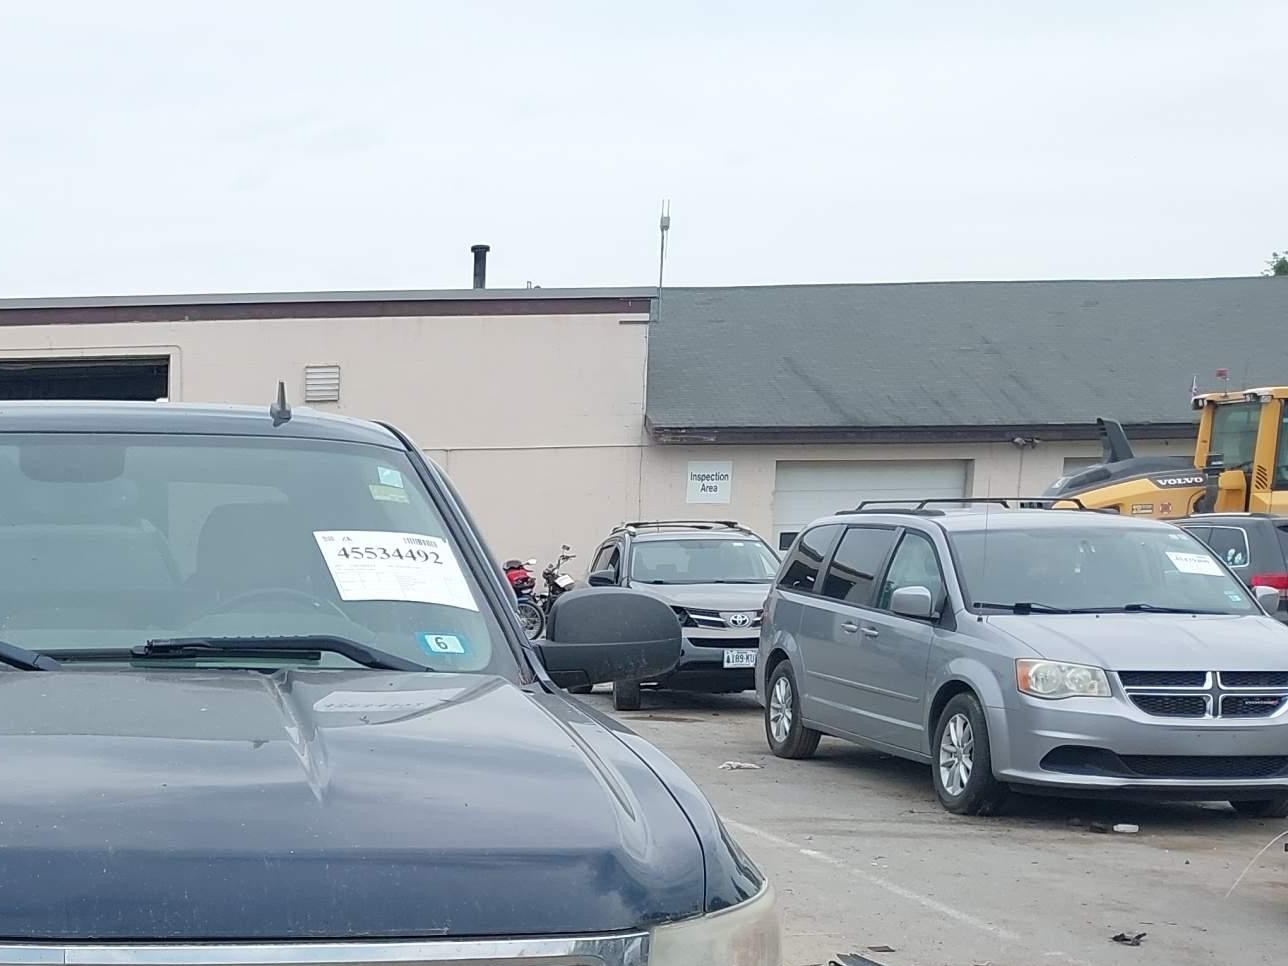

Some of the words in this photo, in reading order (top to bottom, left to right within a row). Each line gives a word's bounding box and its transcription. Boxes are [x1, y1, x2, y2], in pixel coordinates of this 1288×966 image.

[690, 471, 729, 483] Inspection
[1157, 477, 1204, 486] VOLVO
[700, 483, 718, 492] Area
[337, 546, 444, 565] 45534492
[434, 636, 448, 650] 6
